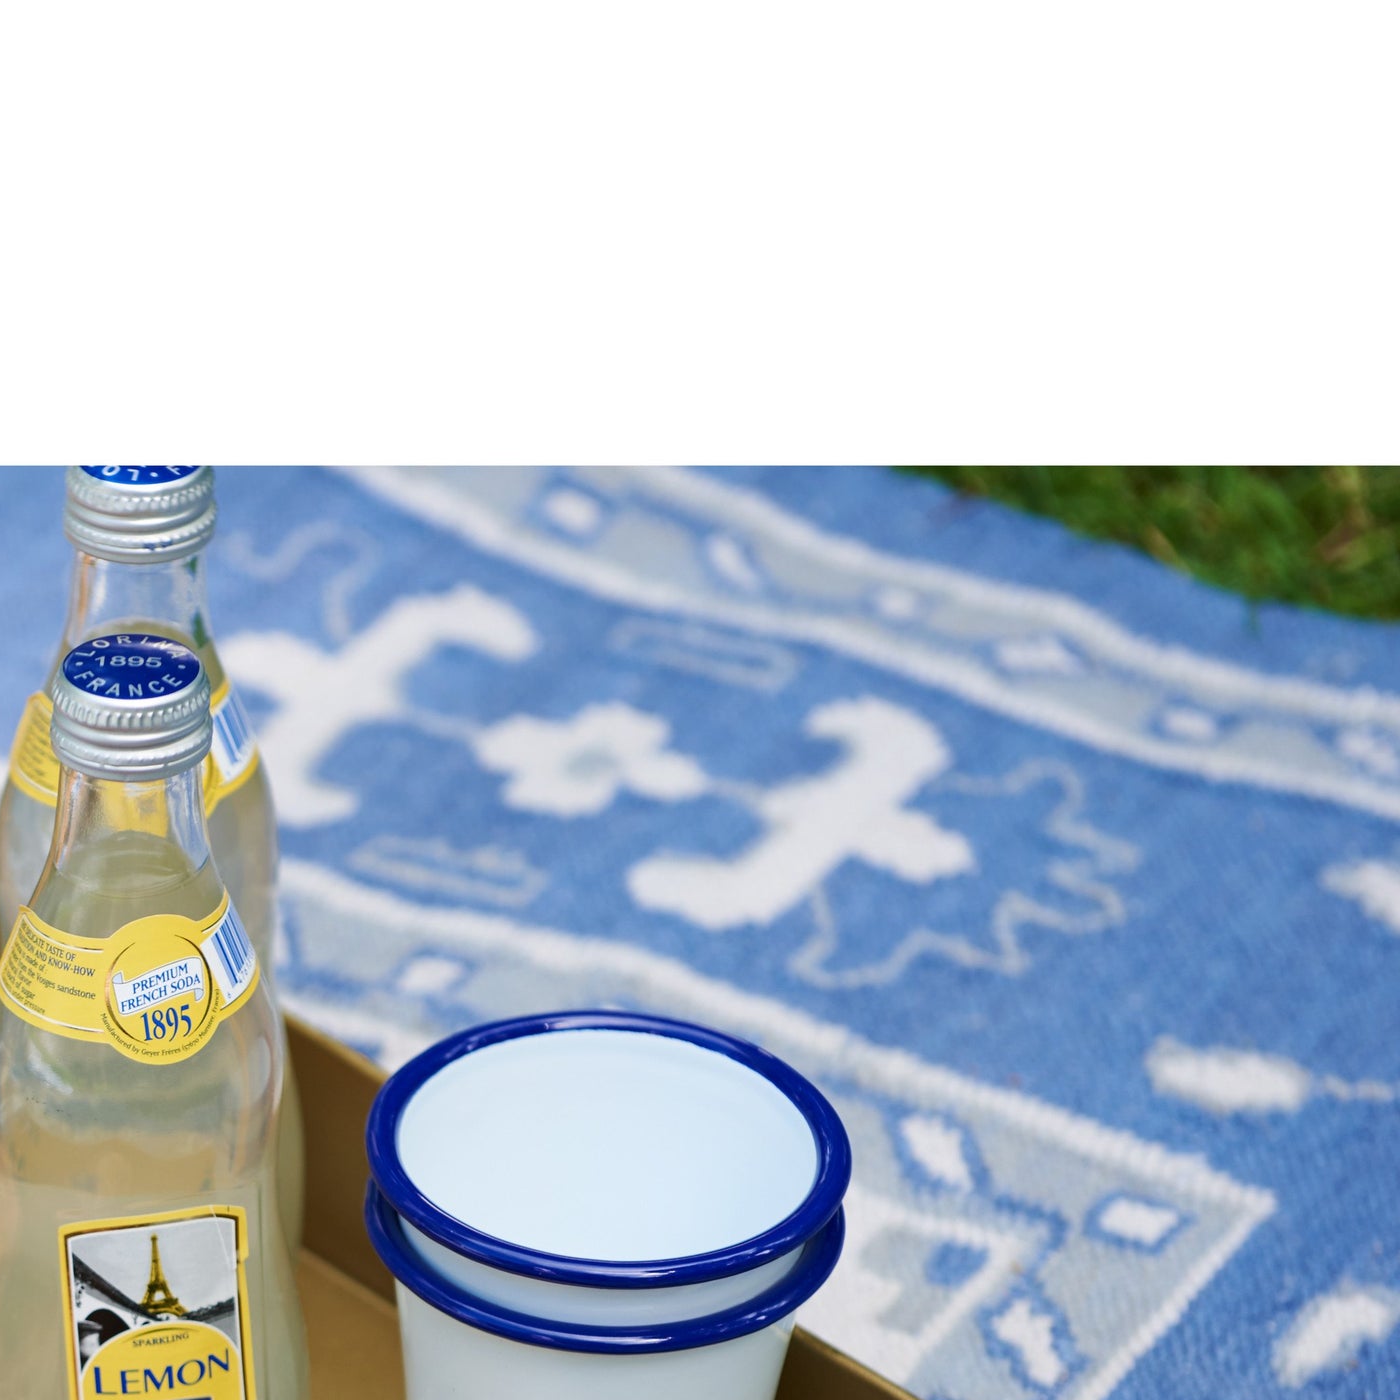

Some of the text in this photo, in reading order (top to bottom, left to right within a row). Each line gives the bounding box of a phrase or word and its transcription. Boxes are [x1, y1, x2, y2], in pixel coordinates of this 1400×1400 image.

[75, 635, 187, 659] LORINA
[95, 655, 162, 668] 1895
[74, 670, 183, 697] FRANCE
[35, 948, 48, 962] AND
[48, 956, 96, 977] KNOW-HOW
[46, 942, 65, 959] TASTE
[65, 952, 76, 961] OF
[56, 983, 96, 1000] sandstone
[132, 962, 189, 994] PREMIUM
[120, 973, 201, 1013] FRENCH SODA
[100, 1012, 135, 1050] Manufactured
[132, 1045, 140, 1055] by
[141, 1048, 160, 1057] Geyer
[140, 1004, 192, 1043] 1895
[132, 1332, 190, 1347] SPARKLING
[94, 1348, 230, 1395] LEMON
